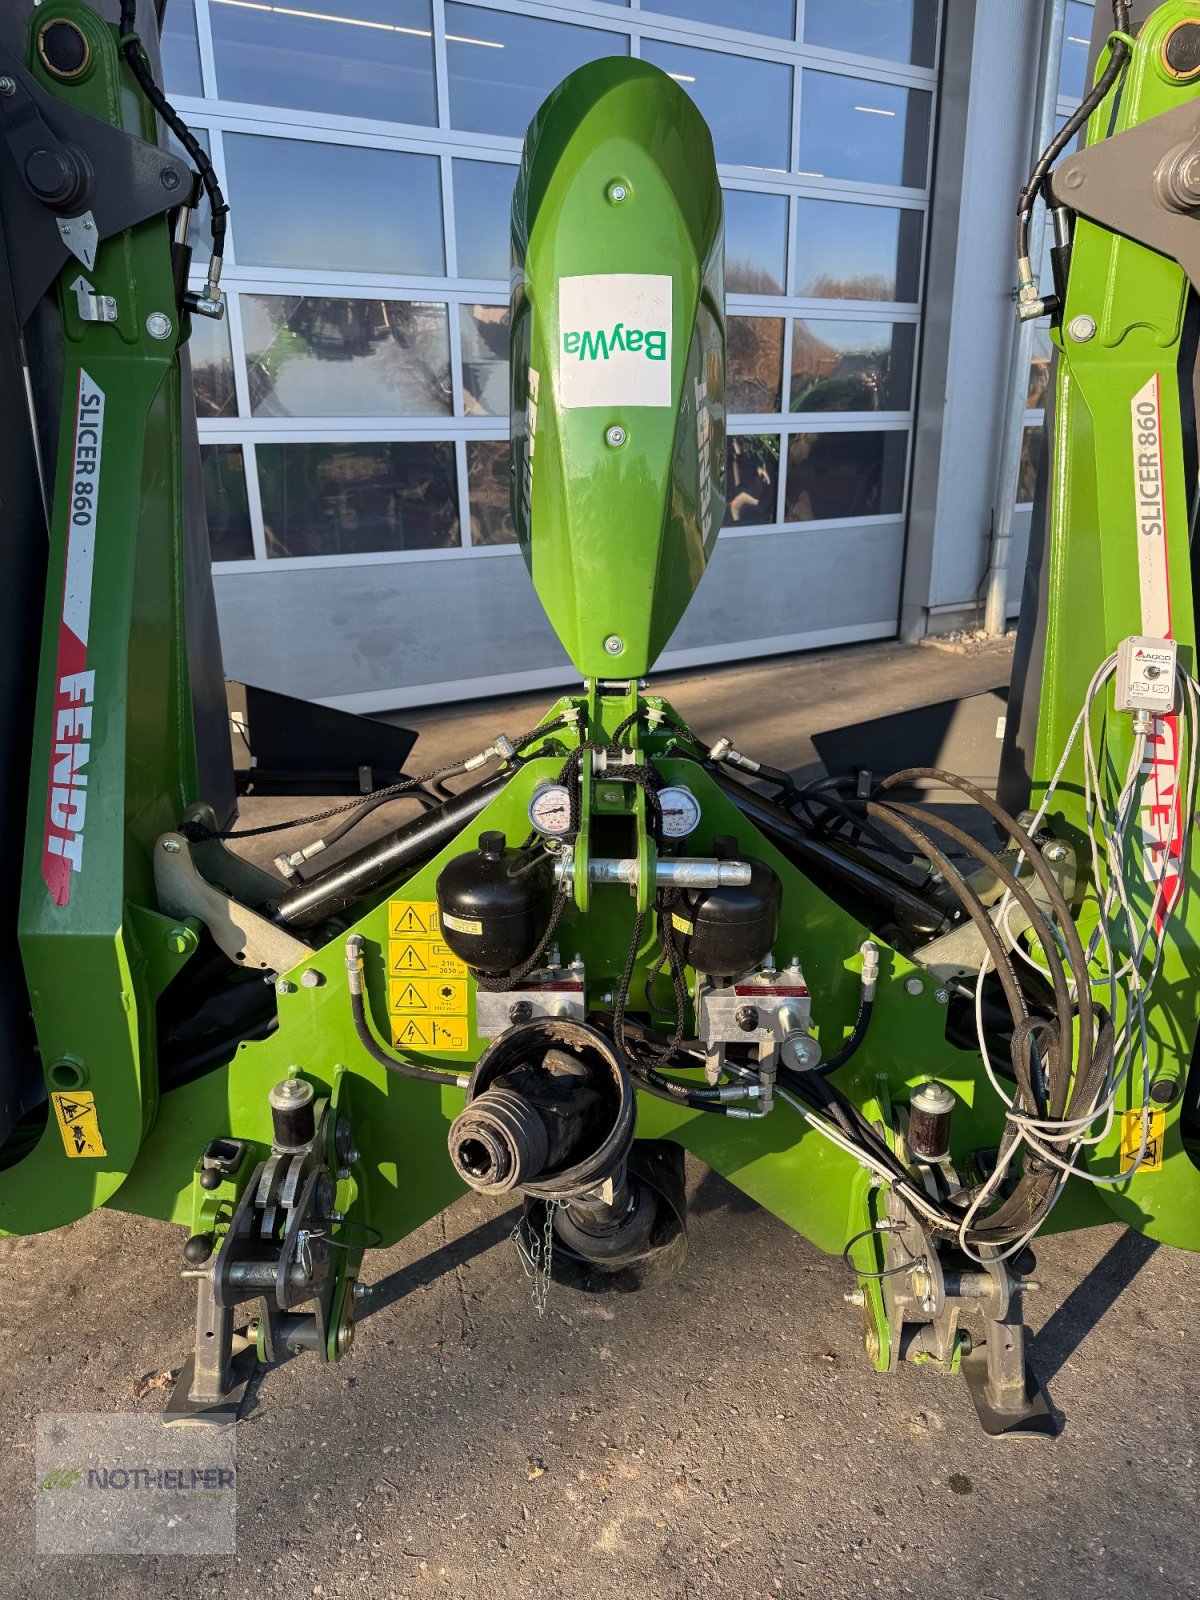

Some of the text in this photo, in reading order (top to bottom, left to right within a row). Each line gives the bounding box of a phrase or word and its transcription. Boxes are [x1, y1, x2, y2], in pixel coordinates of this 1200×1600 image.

[563, 323, 666, 360] BayWa
[72, 394, 101, 526] SLICER 860
[694, 377, 712, 547] FENDT
[1136, 401, 1162, 536] SLICER 860
[1145, 653, 1171, 661] AGCO
[47, 669, 96, 873] FENDT
[1140, 718, 1181, 883] FEND
